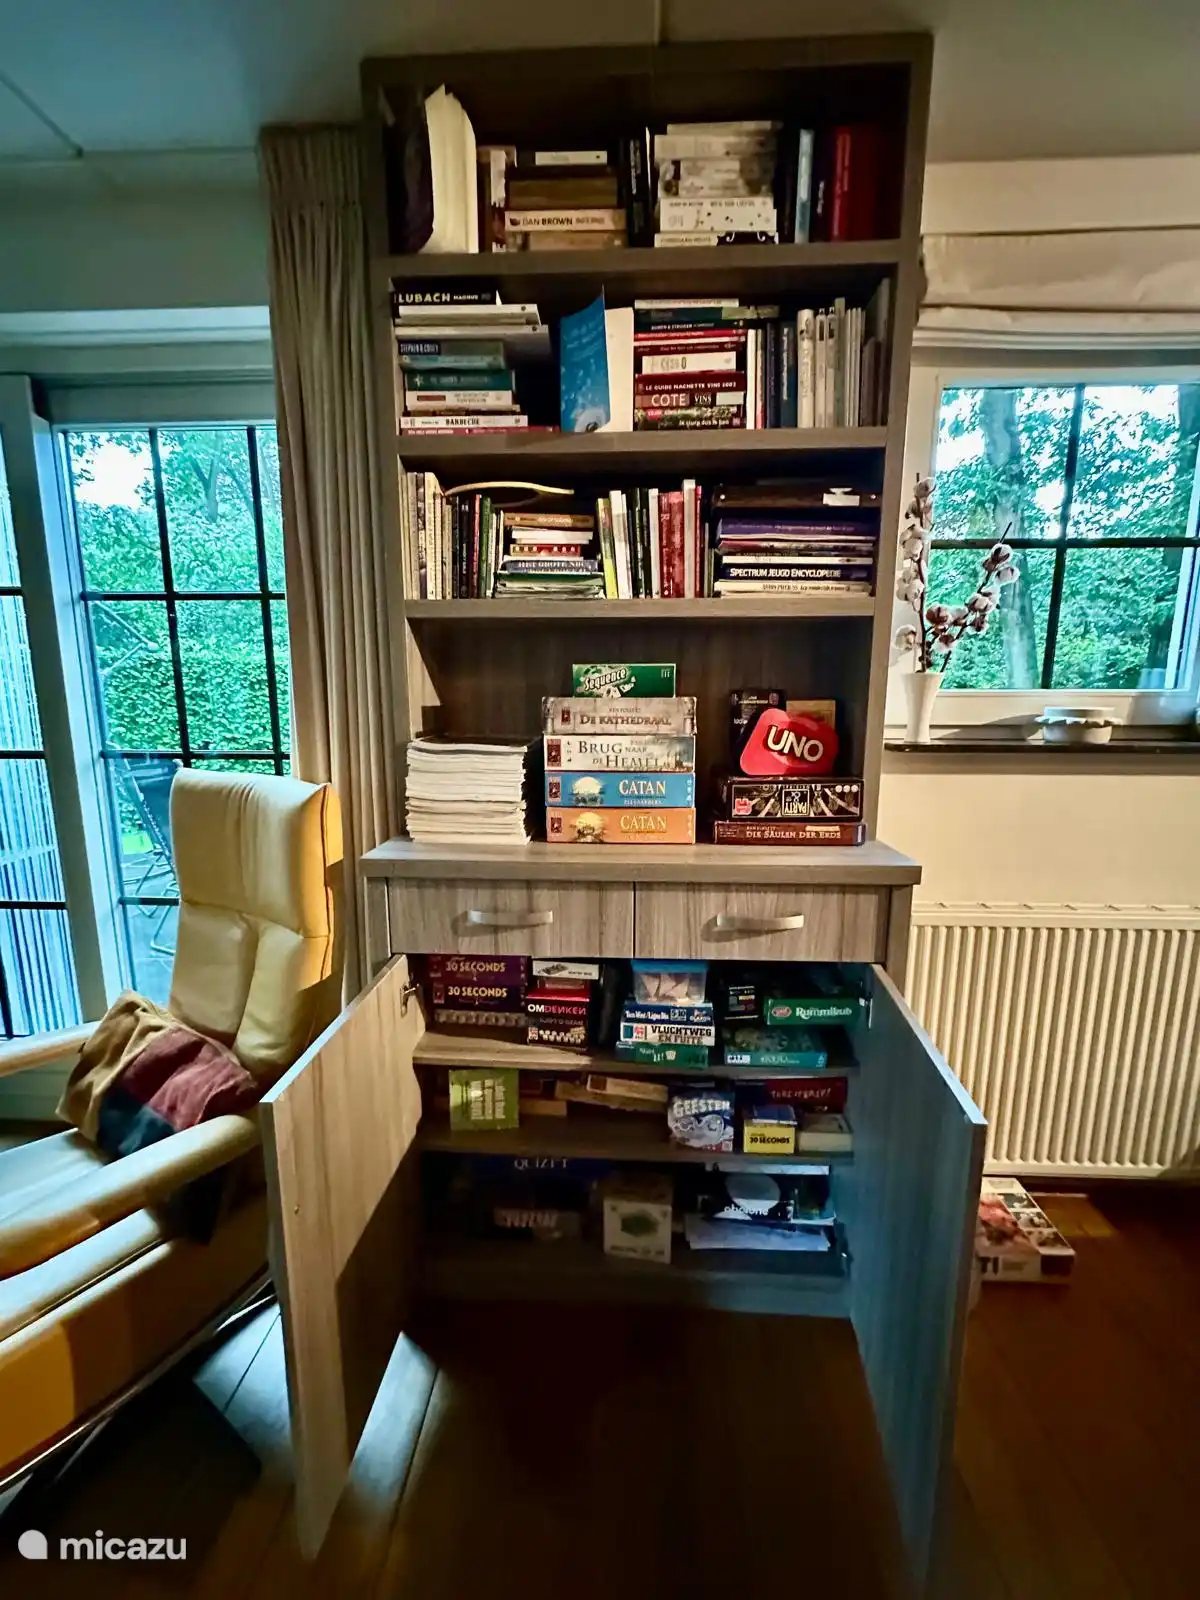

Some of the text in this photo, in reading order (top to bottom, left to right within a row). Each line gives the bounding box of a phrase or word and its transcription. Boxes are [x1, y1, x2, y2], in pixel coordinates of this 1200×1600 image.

[523, 217, 540, 226] DAN
[541, 217, 573, 226] BROWN
[397, 292, 451, 304] LUBACH
[654, 383, 673, 391] GUIDE
[673, 381, 706, 391] HACHETTE
[694, 394, 712, 406] VINS
[729, 567, 842, 579] SPECTRUM JEUGD ENCYCLOPEDIE
[583, 667, 628, 691] Sequence
[580, 714, 672, 727] DE KATHEDRAAL
[578, 740, 623, 754] BRUG
[766, 724, 825, 762] UNO
[618, 779, 667, 796] CATAN
[784, 801, 807, 814] PARTY
[620, 814, 667, 830] CATAN
[745, 830, 762, 839] DIE
[798, 830, 817, 839] DER
[445, 961, 507, 974] 30 SECONDS
[447, 985, 509, 999] 30 SECONDS
[795, 1006, 853, 1020] Rummikub
[650, 1025, 713, 1037] VLUCHTWEG
[658, 1034, 673, 1043] EN
[672, 1098, 731, 1117] GEESTEN
[759, 1136, 790, 1145] SECONDS
